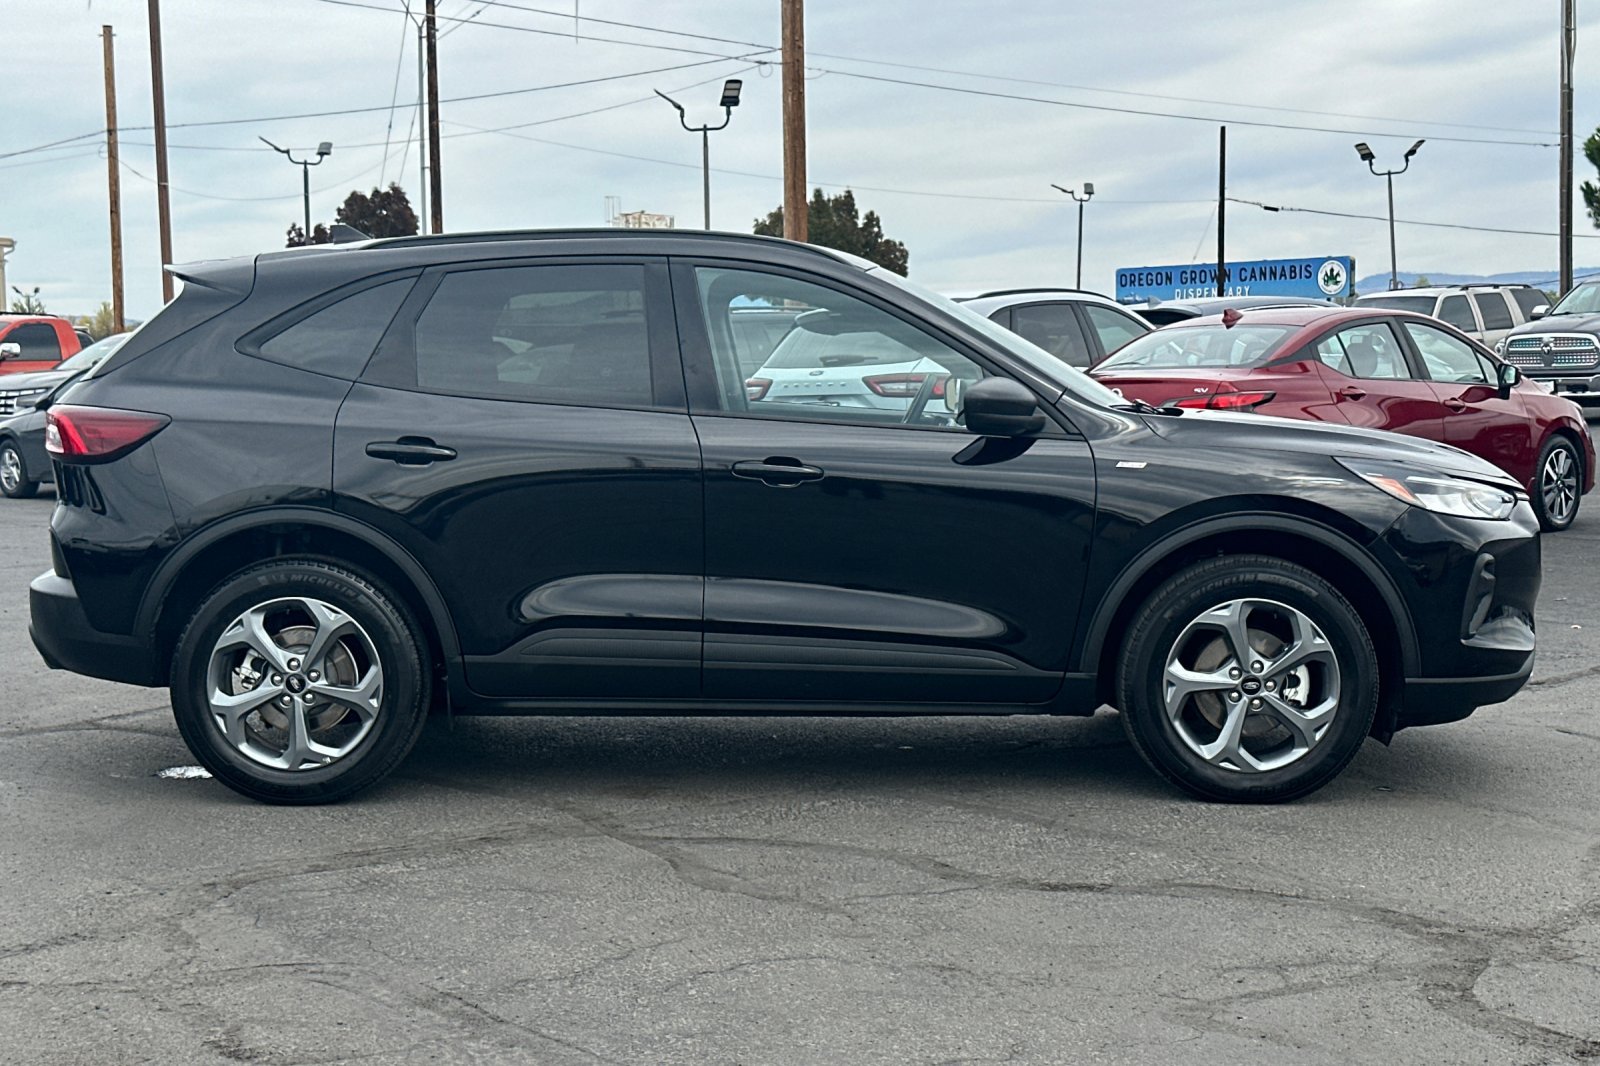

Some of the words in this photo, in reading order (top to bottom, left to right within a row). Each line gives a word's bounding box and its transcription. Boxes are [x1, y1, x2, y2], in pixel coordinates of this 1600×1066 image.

[1120, 271, 1173, 288] OREGON
[1180, 268, 1231, 285] GROWN
[1239, 264, 1313, 282] CANNABIS
[1175, 285, 1250, 299] DISPENARY
[290, 574, 358, 597] MICHELIN
